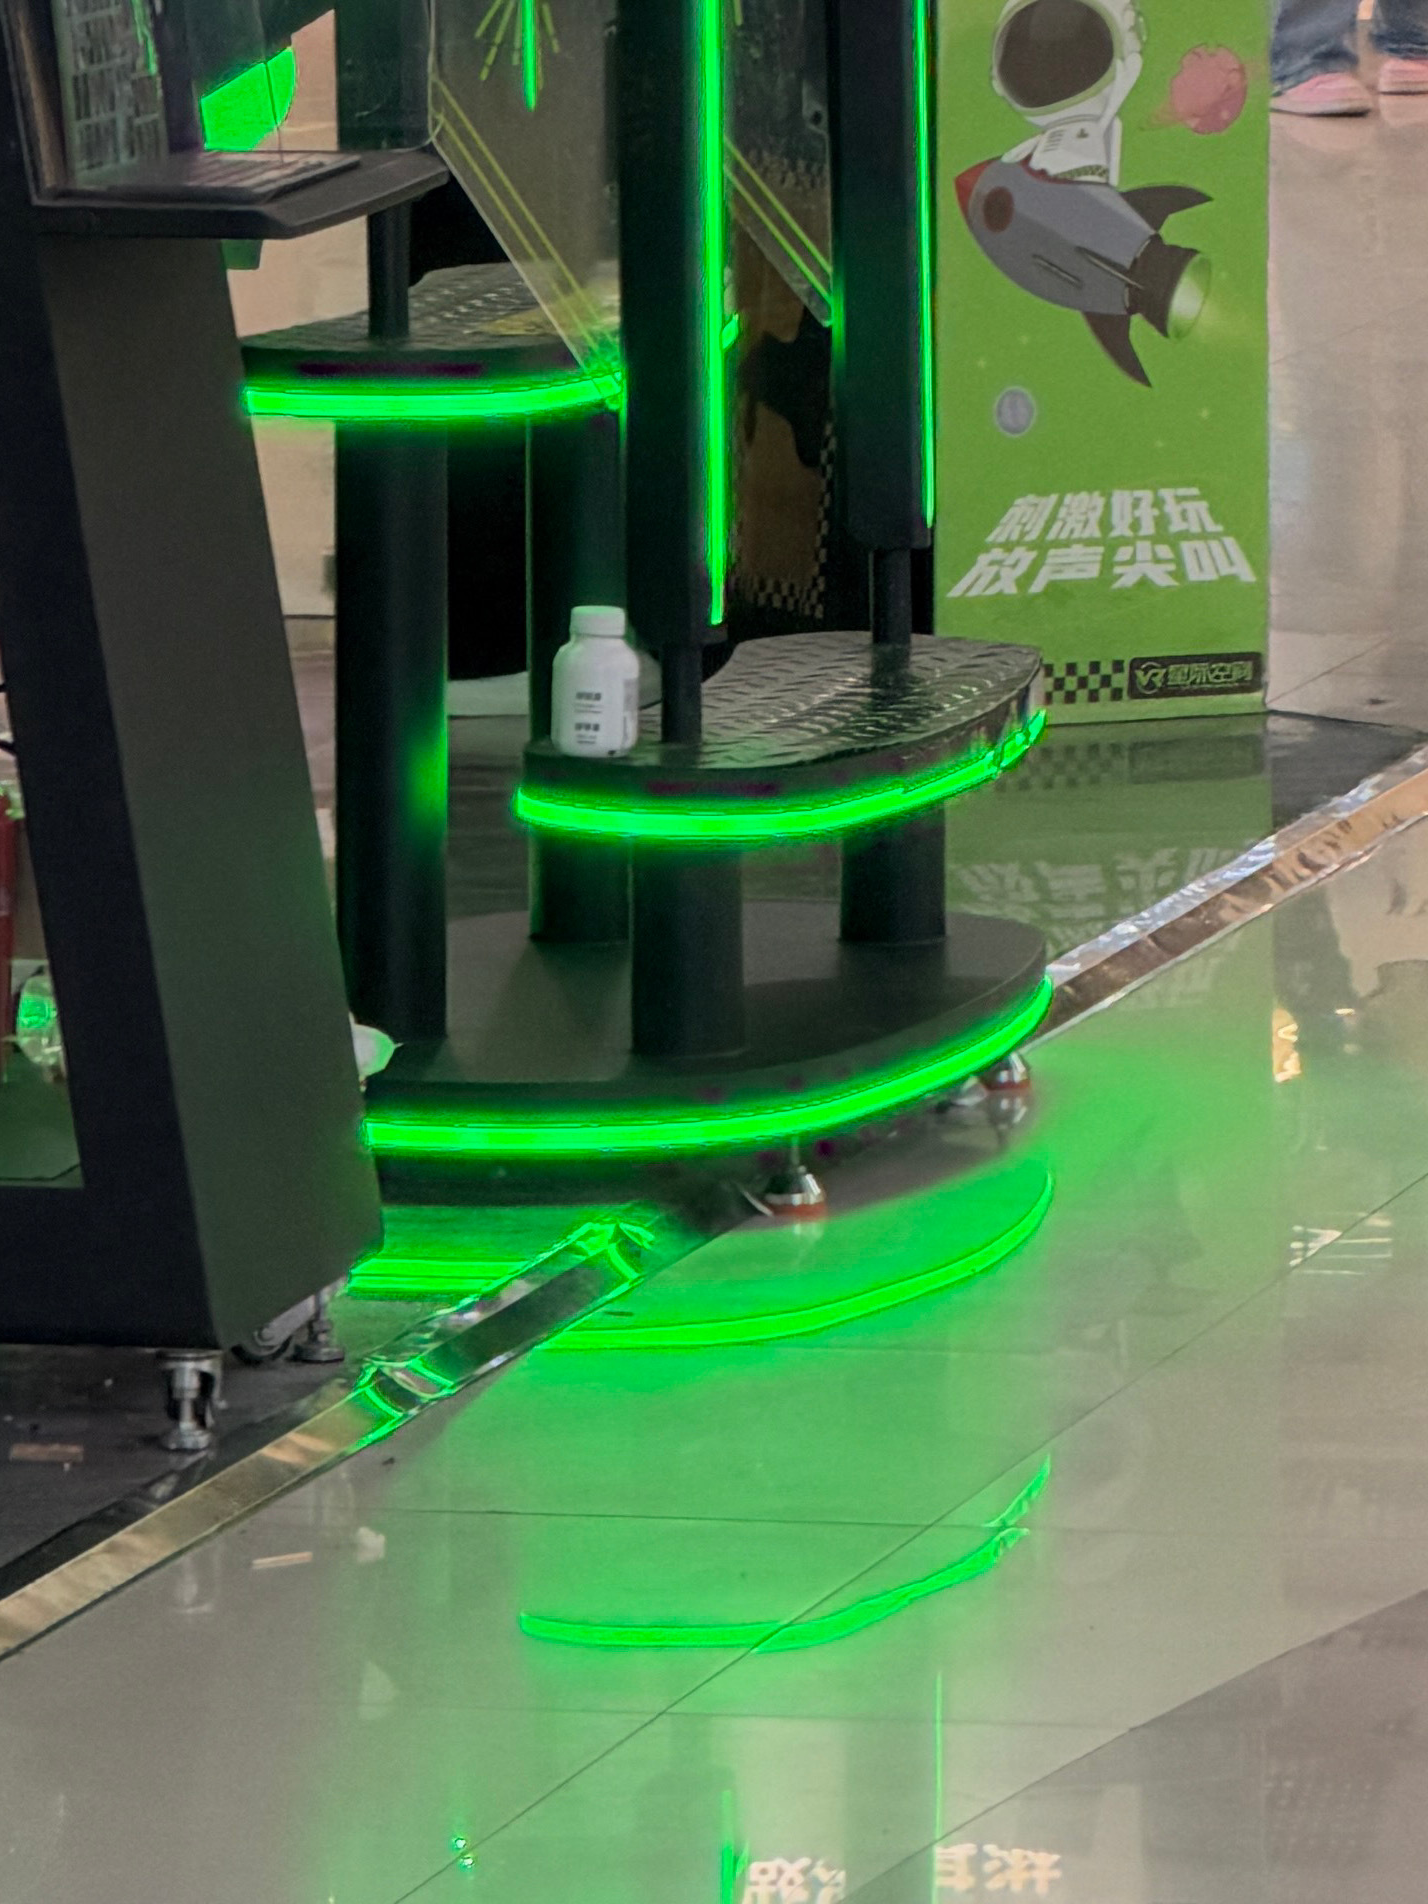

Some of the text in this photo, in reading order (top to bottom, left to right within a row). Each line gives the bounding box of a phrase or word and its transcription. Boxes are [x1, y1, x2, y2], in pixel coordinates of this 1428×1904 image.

[985, 487, 1225, 543] 刺激好玩
[946, 536, 1258, 598] 放声尖叫
